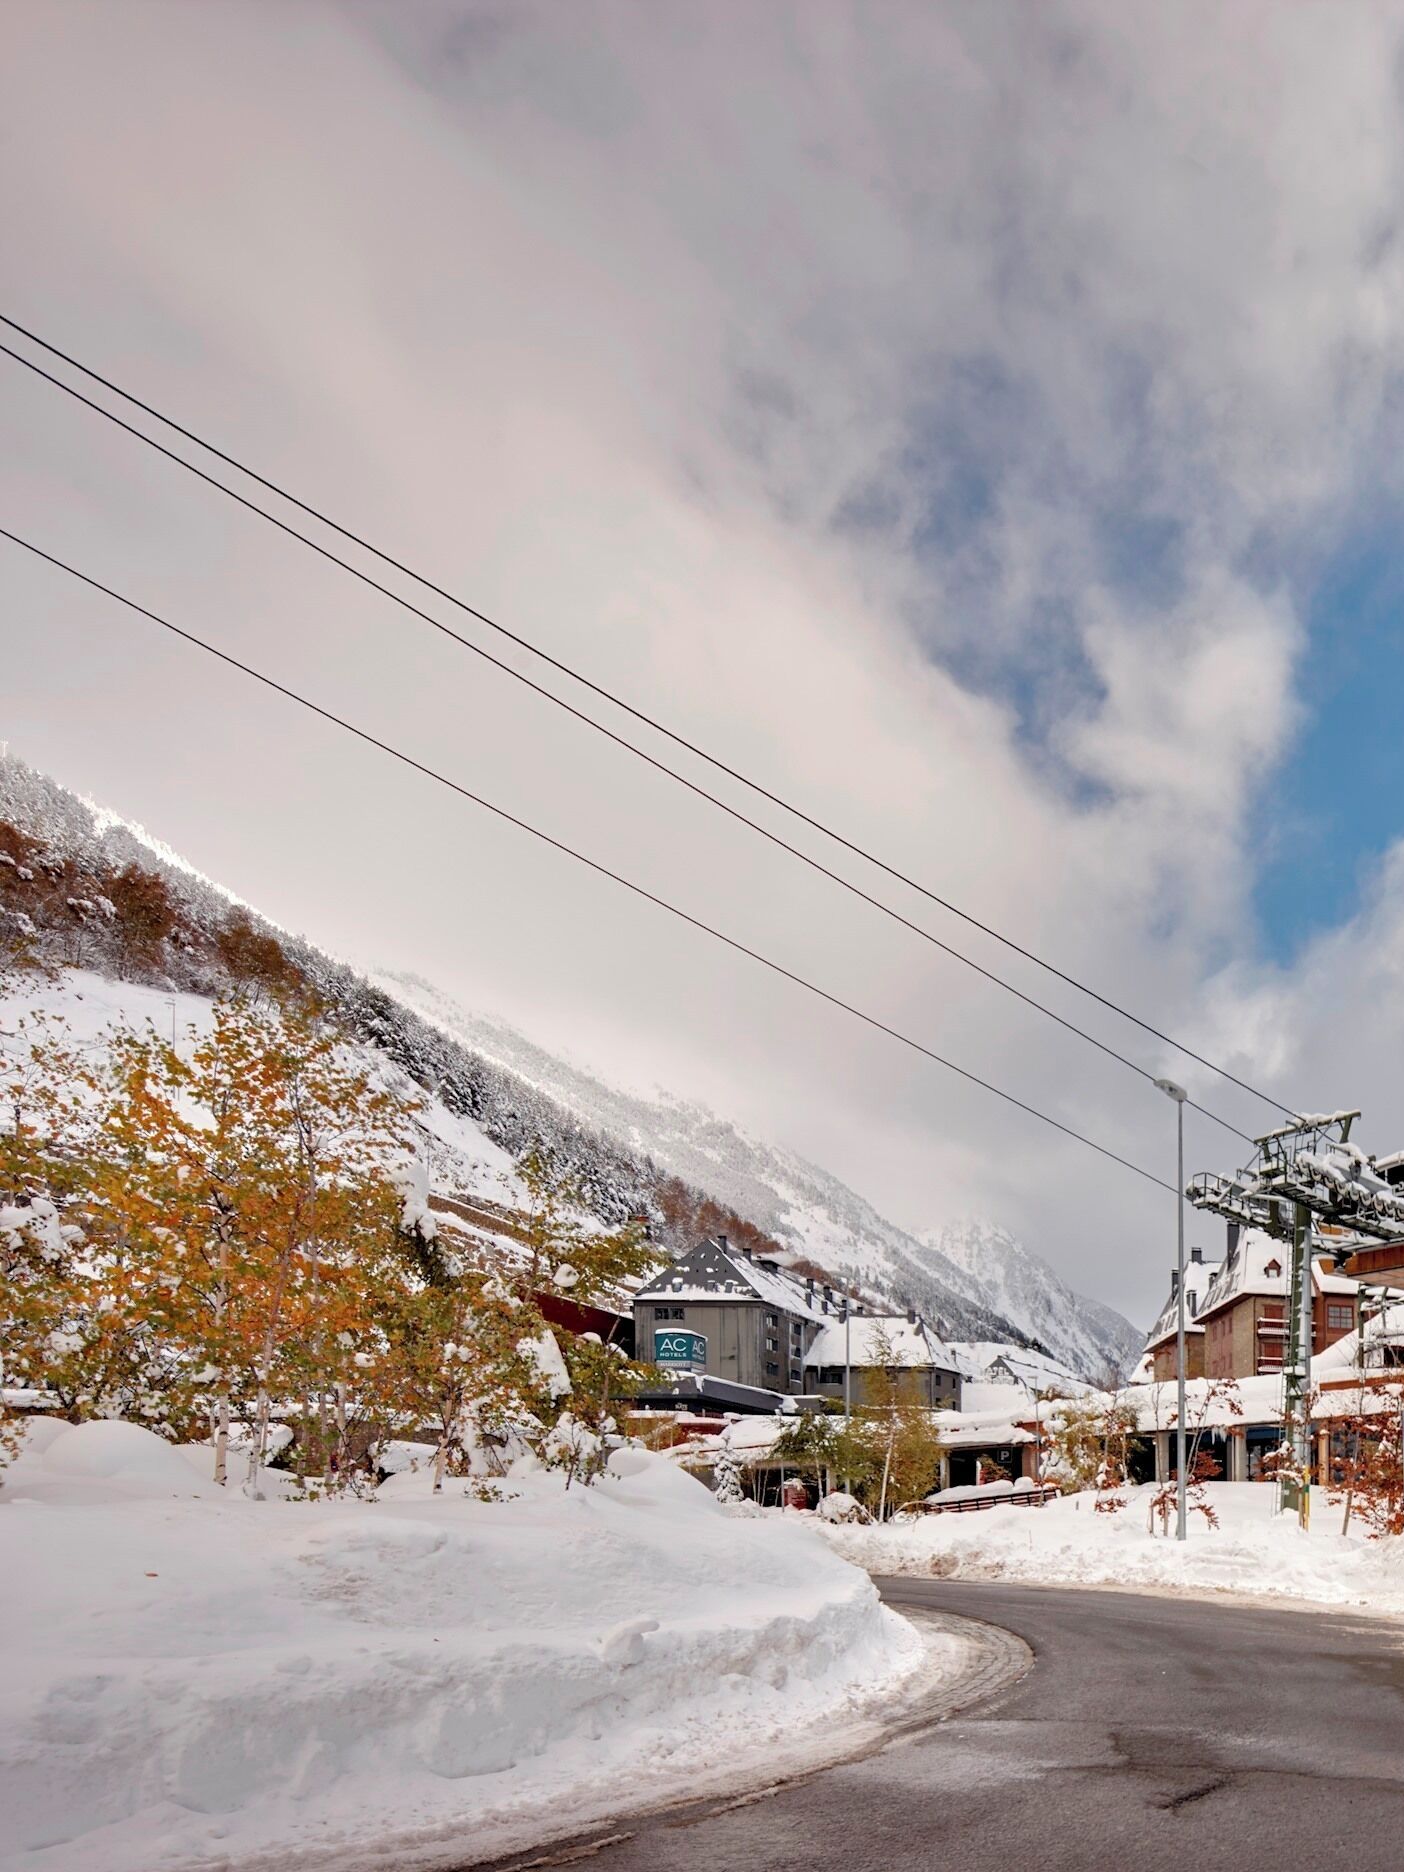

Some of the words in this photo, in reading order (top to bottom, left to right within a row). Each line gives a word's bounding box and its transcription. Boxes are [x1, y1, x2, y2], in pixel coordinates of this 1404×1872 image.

[660, 1338, 687, 1352] AC
[692, 1340, 705, 1355] AC
[1000, 1450, 1010, 1460] P
